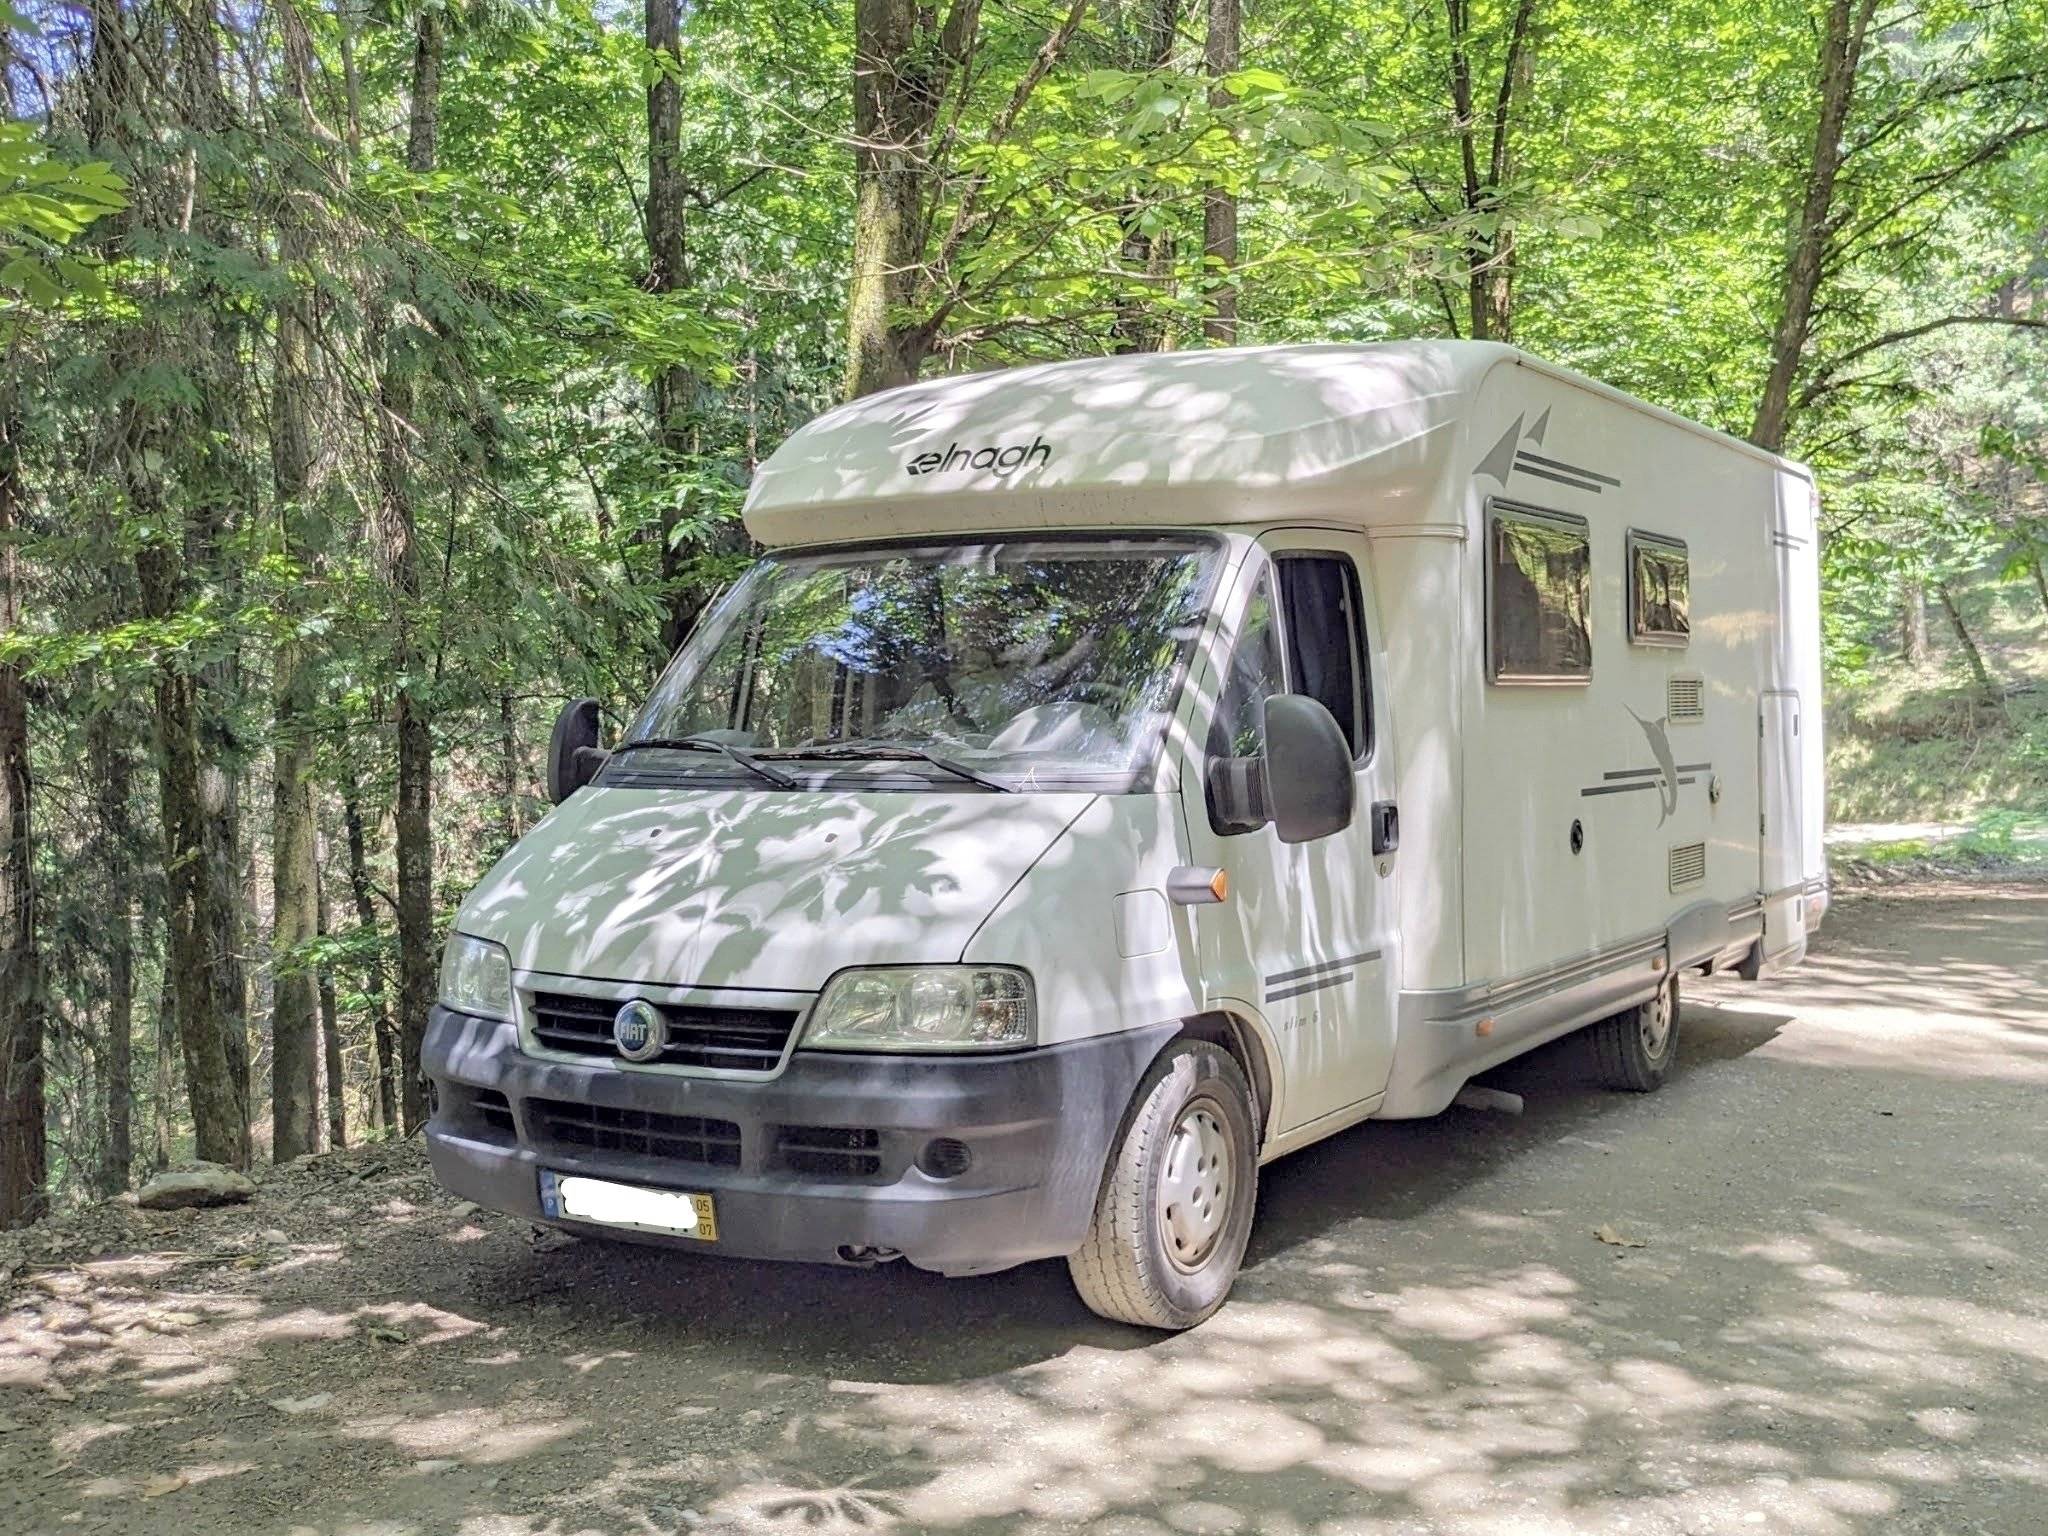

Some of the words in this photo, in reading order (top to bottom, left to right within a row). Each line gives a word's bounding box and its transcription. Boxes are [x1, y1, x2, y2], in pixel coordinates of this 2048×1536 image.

[906, 435, 1052, 478] elnagh
[620, 1022, 647, 1041] FIAT
[696, 1199, 710, 1212] 05
[700, 1223, 712, 1236] 07
